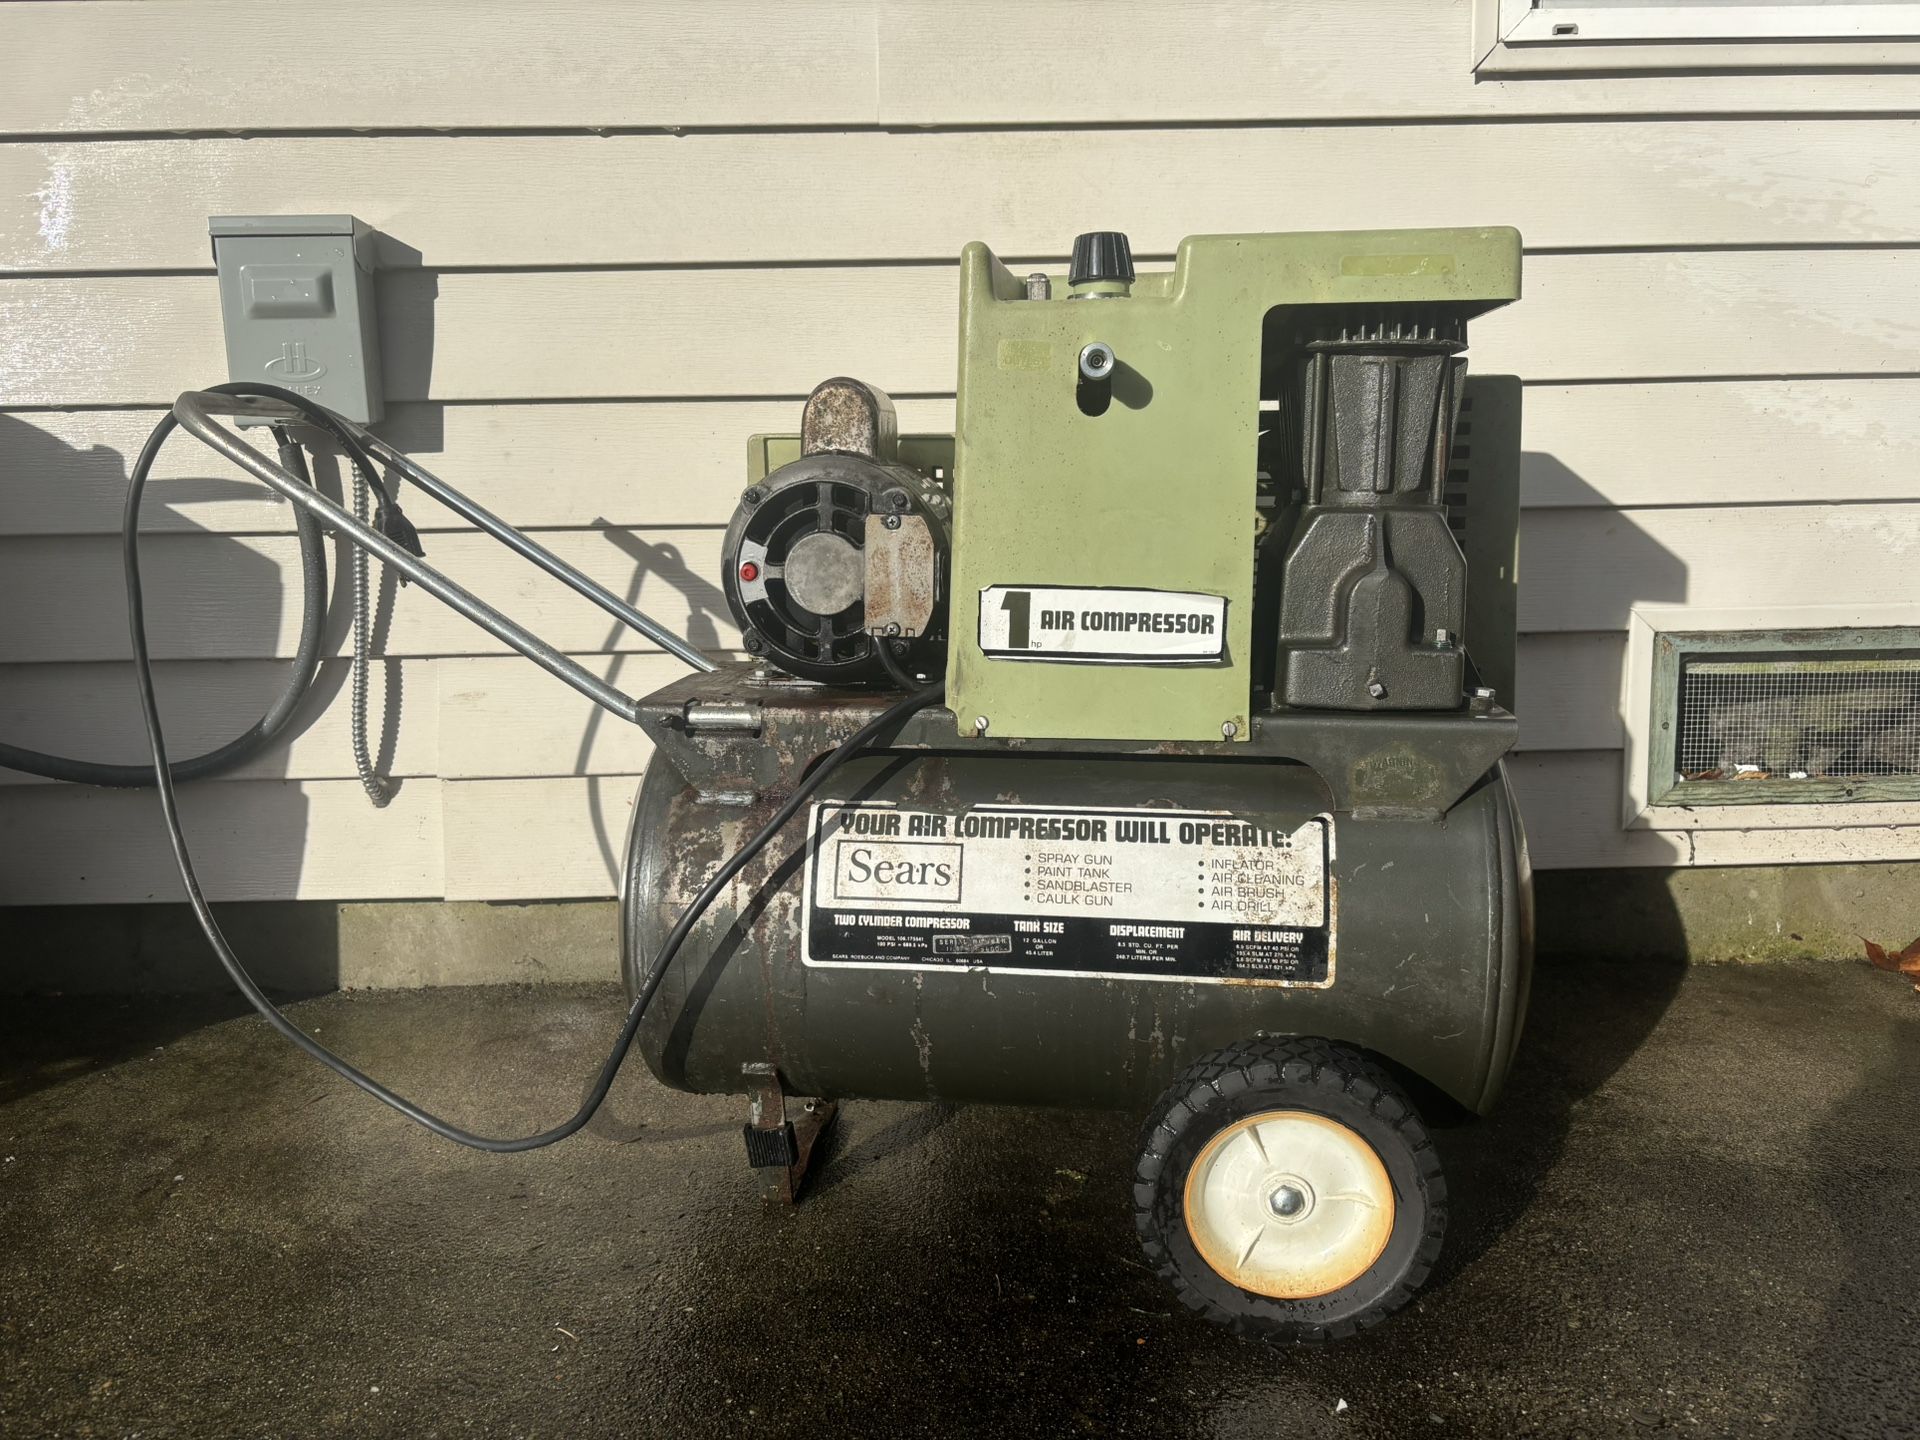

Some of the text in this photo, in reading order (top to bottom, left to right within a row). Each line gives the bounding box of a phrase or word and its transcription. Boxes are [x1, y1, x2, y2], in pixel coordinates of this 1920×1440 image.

[1000, 591, 1031, 649] 1
[1040, 610, 1215, 634] AIR COMPRESSOR
[1031, 640, 1042, 648] hp
[841, 813, 901, 836] YOUR
[908, 814, 947, 837] AIR
[954, 815, 1107, 842] COMPRESSOR
[1115, 820, 1170, 844] WILL
[1037, 853, 1113, 866] SPRAY GUN
[1211, 858, 1275, 871] INFLATOR
[848, 848, 951, 887] Sears
[1037, 866, 1110, 879] PAINT TANK
[1037, 879, 1132, 893] SANDBLASTER
[1211, 872, 1305, 886] AIR CLEANING
[1036, 893, 1113, 906] CAULK GUN
[1211, 886, 1285, 900] AIR BRUSH
[1211, 900, 1273, 912] AIR DRILL
[834, 914, 970, 930] TWO CYLINDER COMPRESSOR
[1014, 920, 1065, 934] TANK SIZE
[1110, 925, 1185, 939] DISPLACEMENT
[1232, 930, 1303, 944] AIR DELIVERY
